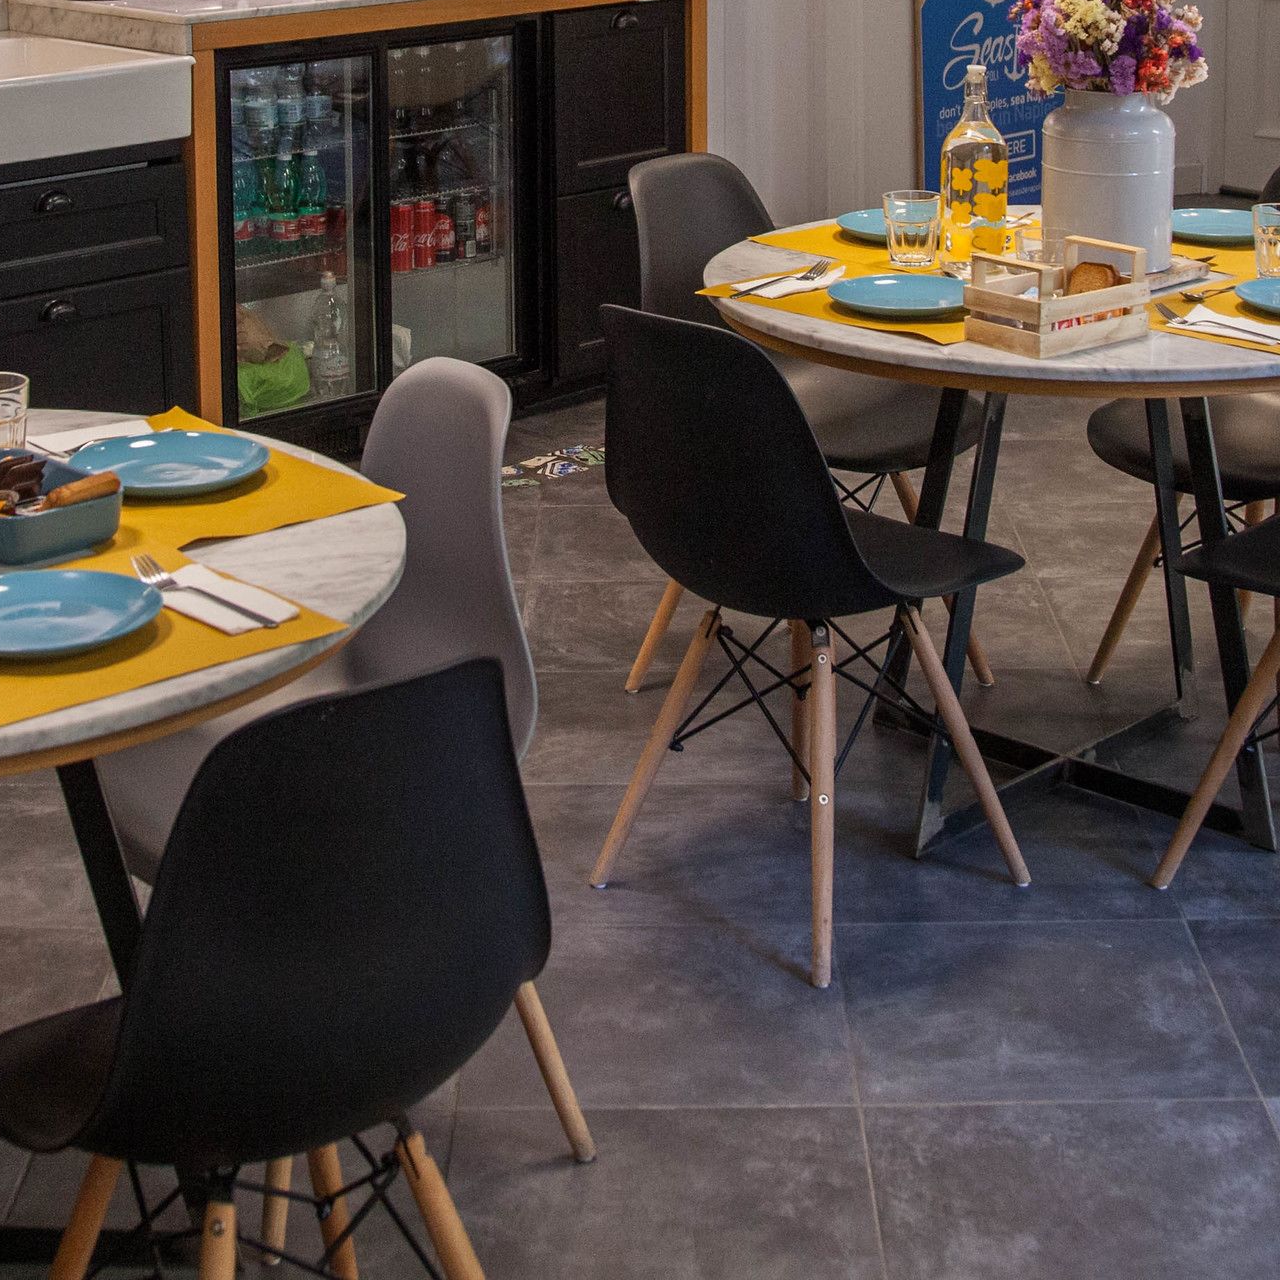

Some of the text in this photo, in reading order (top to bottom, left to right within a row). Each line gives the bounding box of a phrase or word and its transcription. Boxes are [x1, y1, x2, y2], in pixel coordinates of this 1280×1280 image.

[939, 104, 961, 119] don't
[1010, 94, 1025, 106] sea
[1007, 139, 1026, 156] ERE
[1008, 167, 1037, 182] acebook
